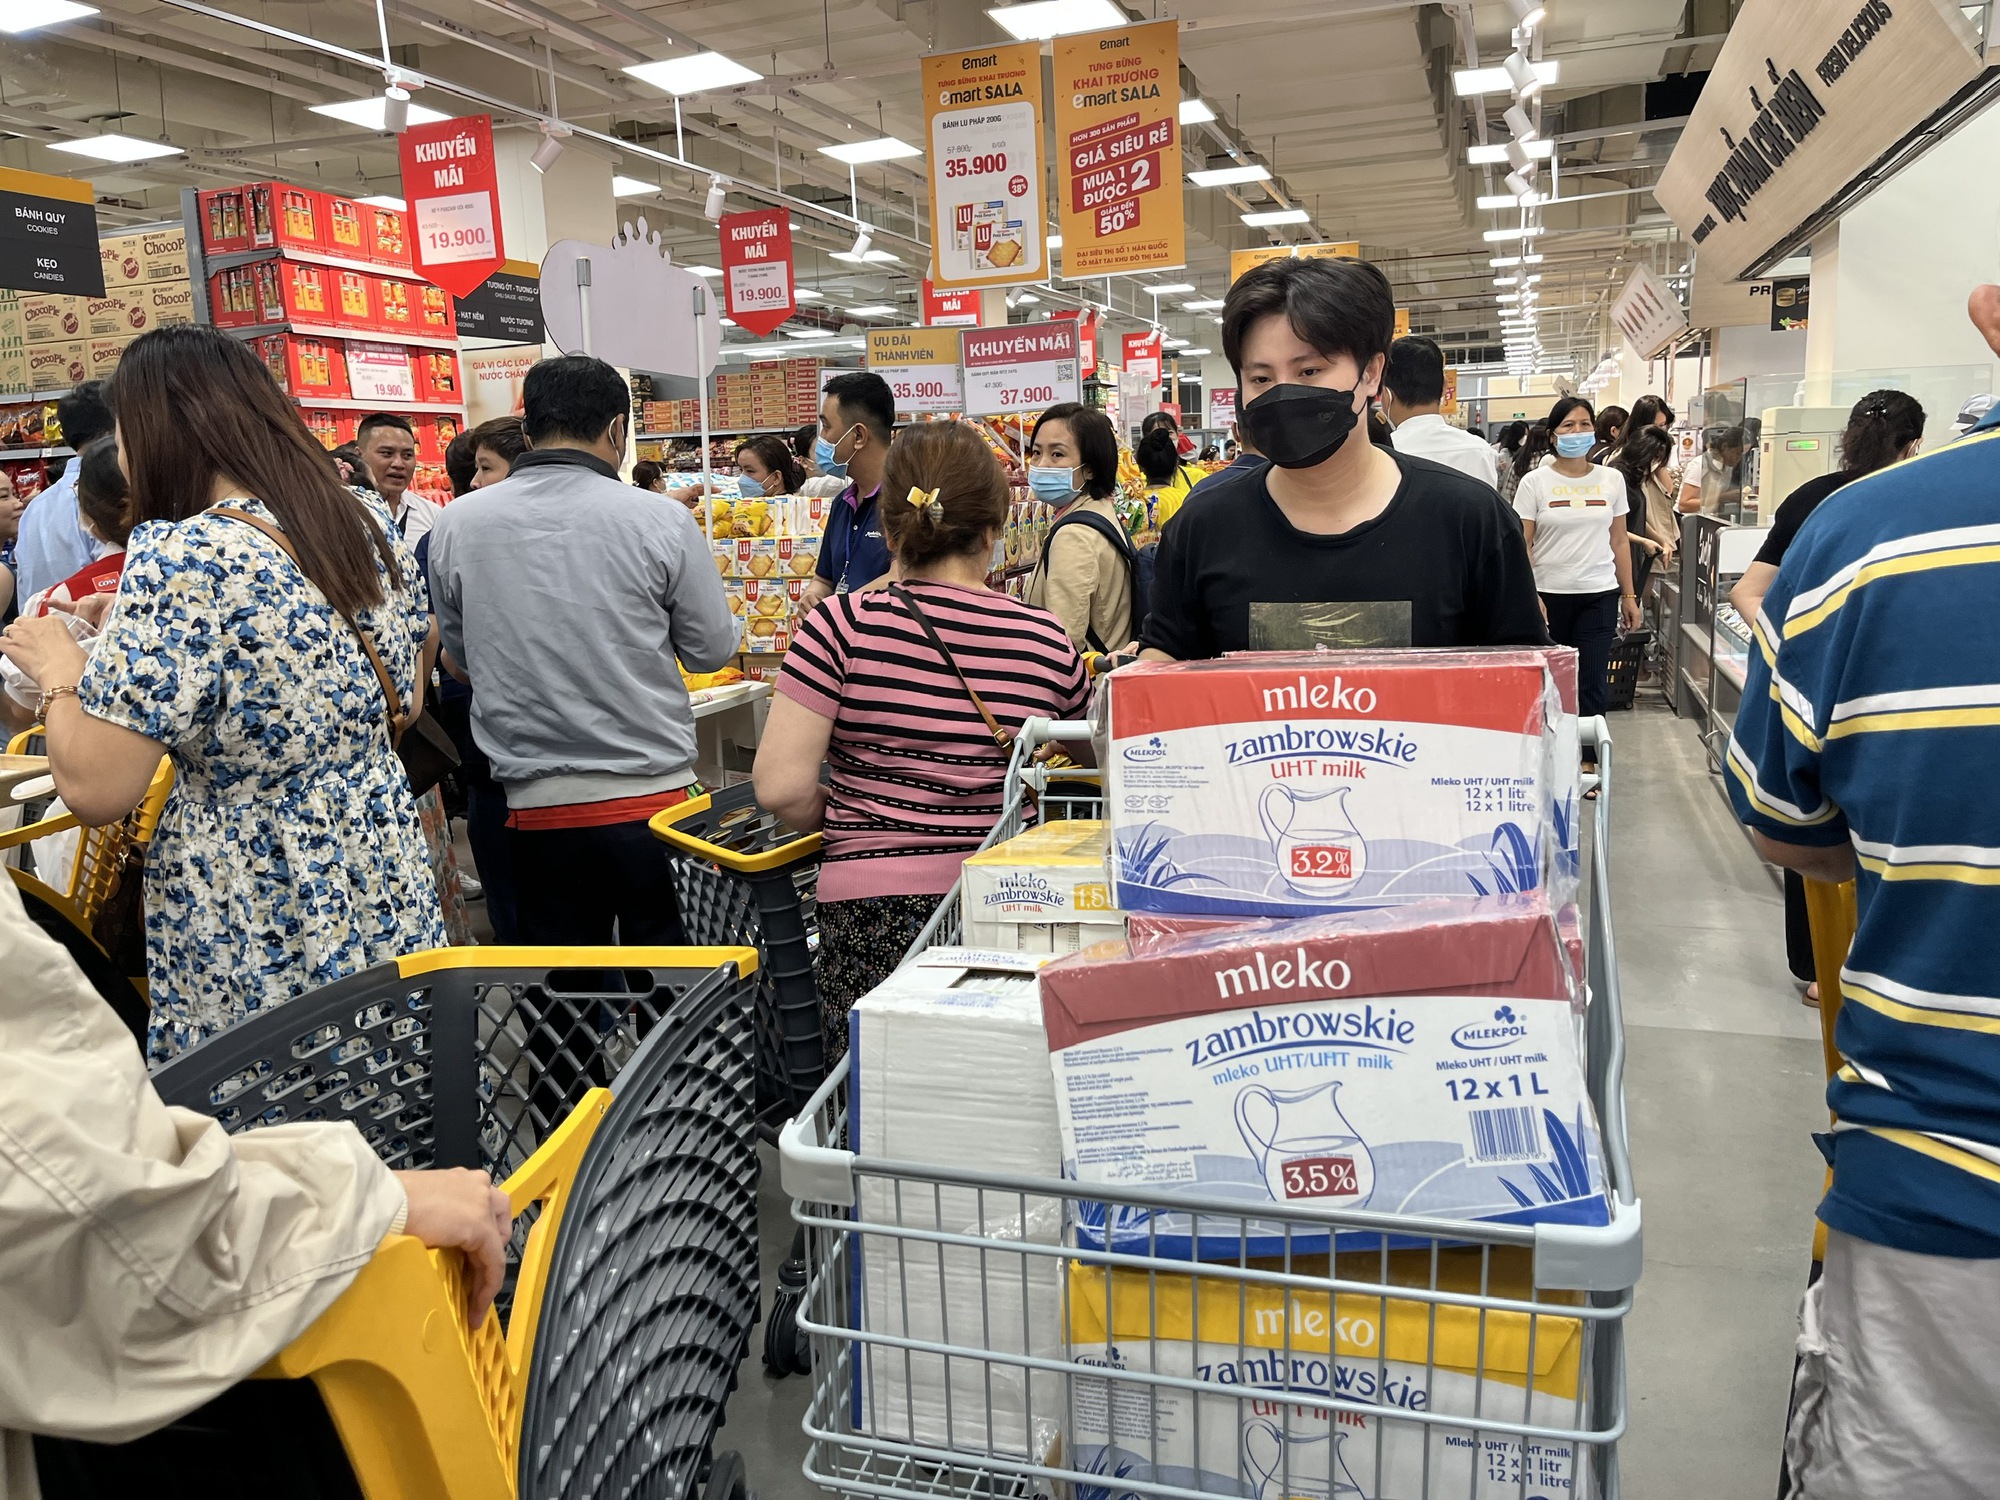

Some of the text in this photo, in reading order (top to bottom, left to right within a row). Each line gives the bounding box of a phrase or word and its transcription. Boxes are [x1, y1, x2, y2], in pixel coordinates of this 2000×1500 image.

[1100, 37, 1130, 50] emart
[1815, 0, 1892, 88] FRESH DELICIOUS
[962, 54, 998, 70] emart
[1073, 68, 1160, 90] KHAI TRƯƠNG
[940, 82, 1023, 106] emart SALA
[1072, 84, 1160, 108] emart SALA
[1765, 57, 1826, 144] BIẾN
[1072, 134, 1088, 142] HƠN
[1090, 129, 1100, 138] 300
[1749, 86, 1795, 167] CHẾ
[415, 132, 476, 163] KHUYẾN
[1075, 122, 1168, 168] GIÁ SIÊU RẺ
[946, 153, 1006, 178] 35.900
[1720, 127, 1774, 201] PHẨM
[434, 164, 464, 188] MÃI
[1082, 160, 1150, 191] MUA 1 2
[1083, 182, 1128, 206] ĐƯỢC
[1704, 172, 1747, 222] THỰC
[15, 207, 66, 224] BÁNH QUY
[959, 208, 970, 224] LU
[1100, 209, 1135, 234] 50%
[26, 224, 58, 235] COOKIES
[428, 228, 486, 249] 19.900
[732, 220, 778, 241] KHUYẾN
[977, 228, 990, 242] LU
[144, 238, 185, 256] ChocoP
[744, 242, 767, 259] MÃI
[36, 258, 58, 270] KẸO
[34, 272, 64, 282] CANDIES
[153, 291, 190, 306] ChocoP
[739, 286, 782, 302] 19.900
[943, 299, 961, 312] MÃI
[874, 335, 910, 348] ƯU ĐÃI
[970, 334, 1071, 358] KHUYẾN MÃI
[874, 346, 934, 361] THÀNH VIÊN
[473, 362, 485, 370] GIA
[488, 361, 494, 371] VỊ
[498, 358, 512, 368] CÁC
[480, 371, 502, 380] NƯỚC
[375, 384, 402, 396] 19.900
[893, 382, 942, 398] 35.900
[1000, 386, 1052, 405] 37.900
[812, 500, 820, 514] LU
[740, 543, 748, 554] LU
[780, 541, 790, 553] LU
[98, 578, 117, 587] COSY
[746, 582, 756, 594] LU
[790, 582, 799, 594] LU
[1262, 676, 1376, 713] mleko
[1225, 724, 1418, 764] zambrowskie
[1270, 760, 1367, 779] UHT milk
[1432, 778, 1460, 786] Mleko
[1464, 778, 1483, 786] UHT
[1491, 778, 1510, 786] UHT
[1513, 777, 1534, 786] milk
[1466, 788, 1481, 799] 12
[1485, 791, 1493, 799] x
[1497, 788, 1504, 799] 1
[1466, 801, 1482, 812] 12
[1497, 801, 1504, 812] 1
[1509, 801, 1535, 812] litre
[1294, 850, 1350, 876] 3,2%
[1000, 872, 1047, 890] mleko
[984, 887, 1064, 906] zambrowskie
[1002, 904, 1043, 912] UHT milk
[1215, 948, 1351, 998] mleko
[1186, 1004, 1415, 1066] zambrowskie
[1464, 1026, 1528, 1040] MLEKPOL
[1212, 1052, 1393, 1086] mleko UHT/UHT milk
[1436, 1060, 1468, 1071] Mleko
[1469, 1058, 1492, 1068] UHT
[1500, 1055, 1522, 1066] UHT
[1525, 1053, 1548, 1064] milk
[1446, 1072, 1549, 1102] 12 x 1 L
[1286, 1164, 1356, 1195] 3,5%
[1486, 1442, 1572, 1458] UHT milk
[1487, 1454, 1562, 1472] 12 x 1 litr
[1488, 1469, 1571, 1488] 12 x 1 litre
